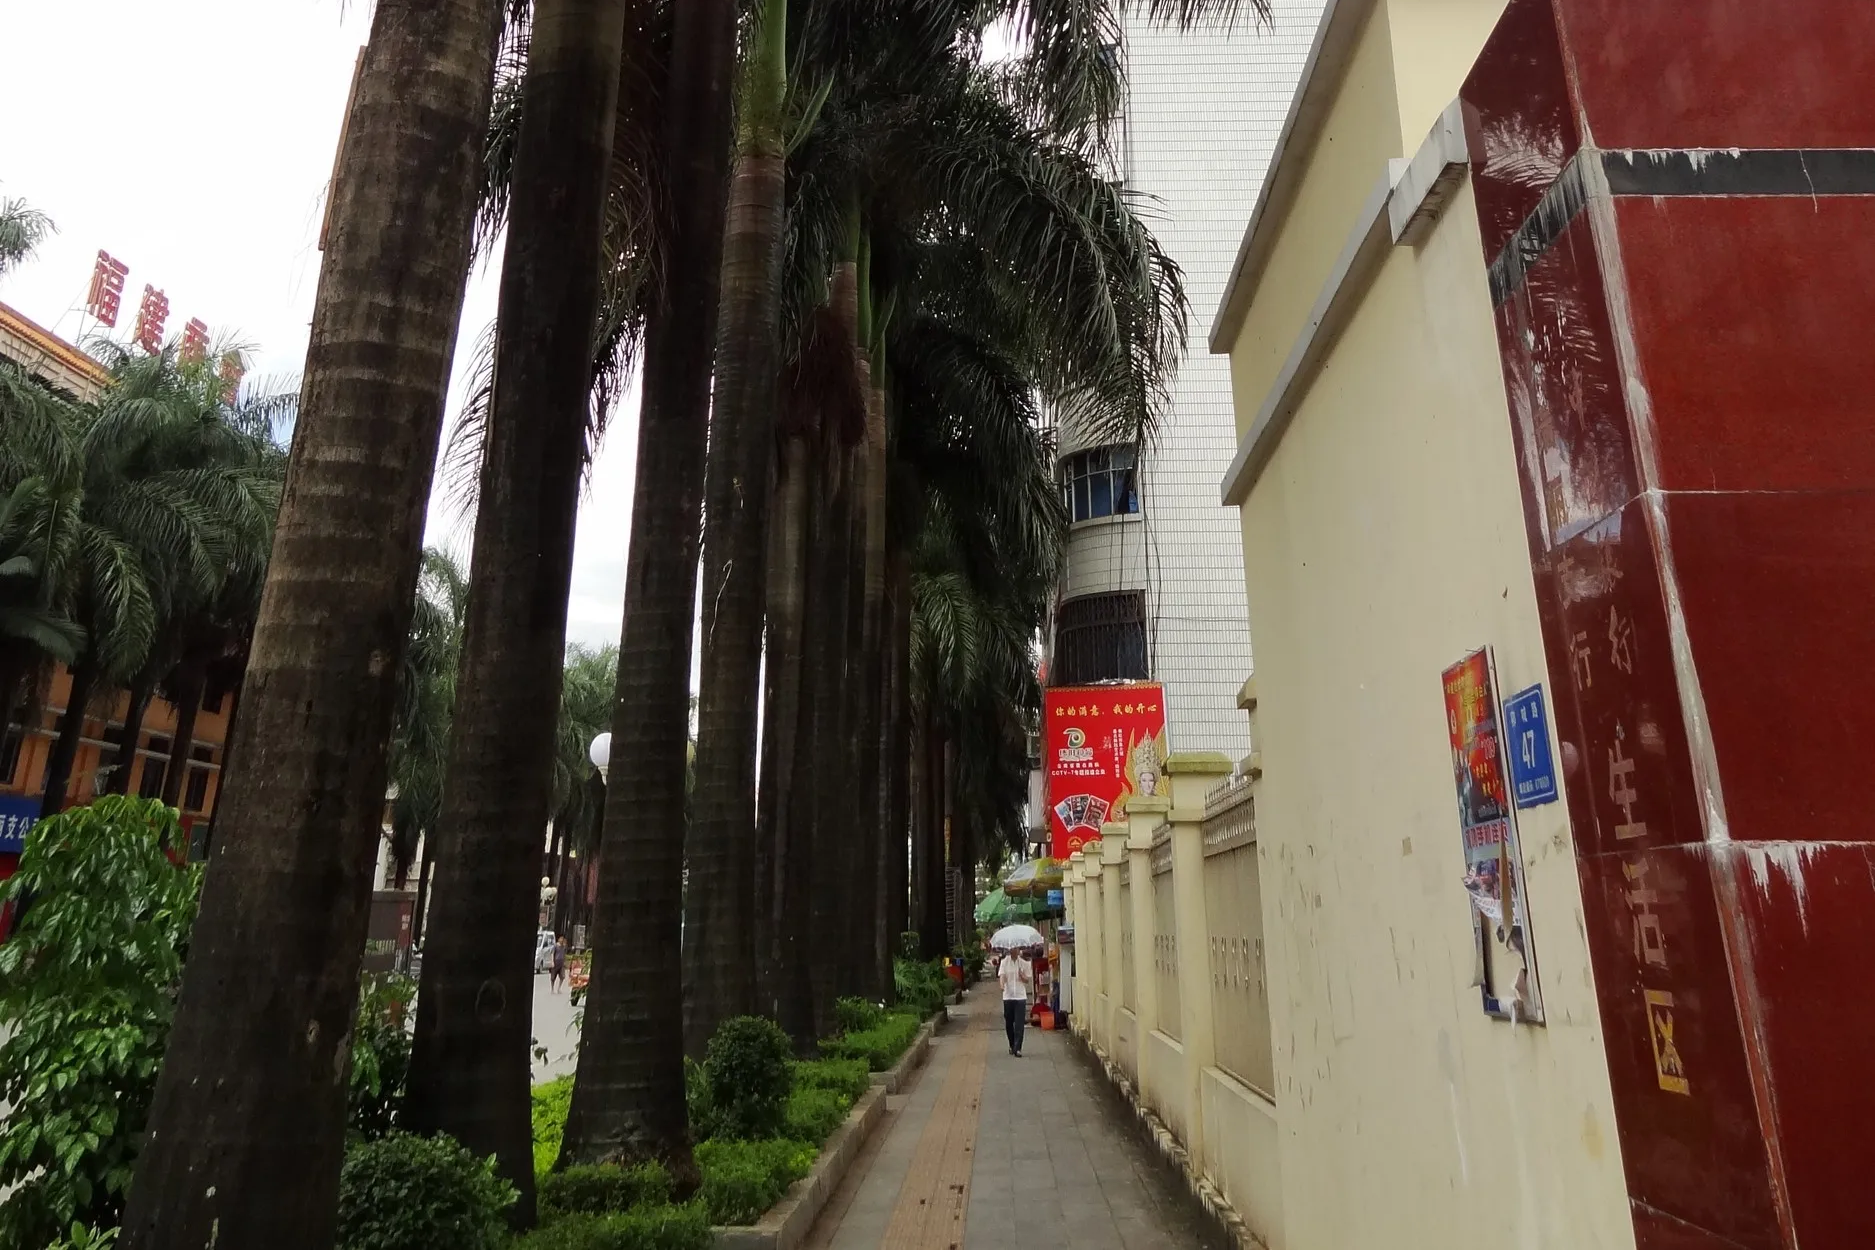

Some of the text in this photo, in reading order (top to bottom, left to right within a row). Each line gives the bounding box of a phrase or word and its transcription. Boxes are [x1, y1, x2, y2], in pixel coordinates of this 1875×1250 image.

[1522, 730, 1536, 769] 47
[0, 814, 39, 840] 支公
[1609, 737, 1690, 1096] 生活区
